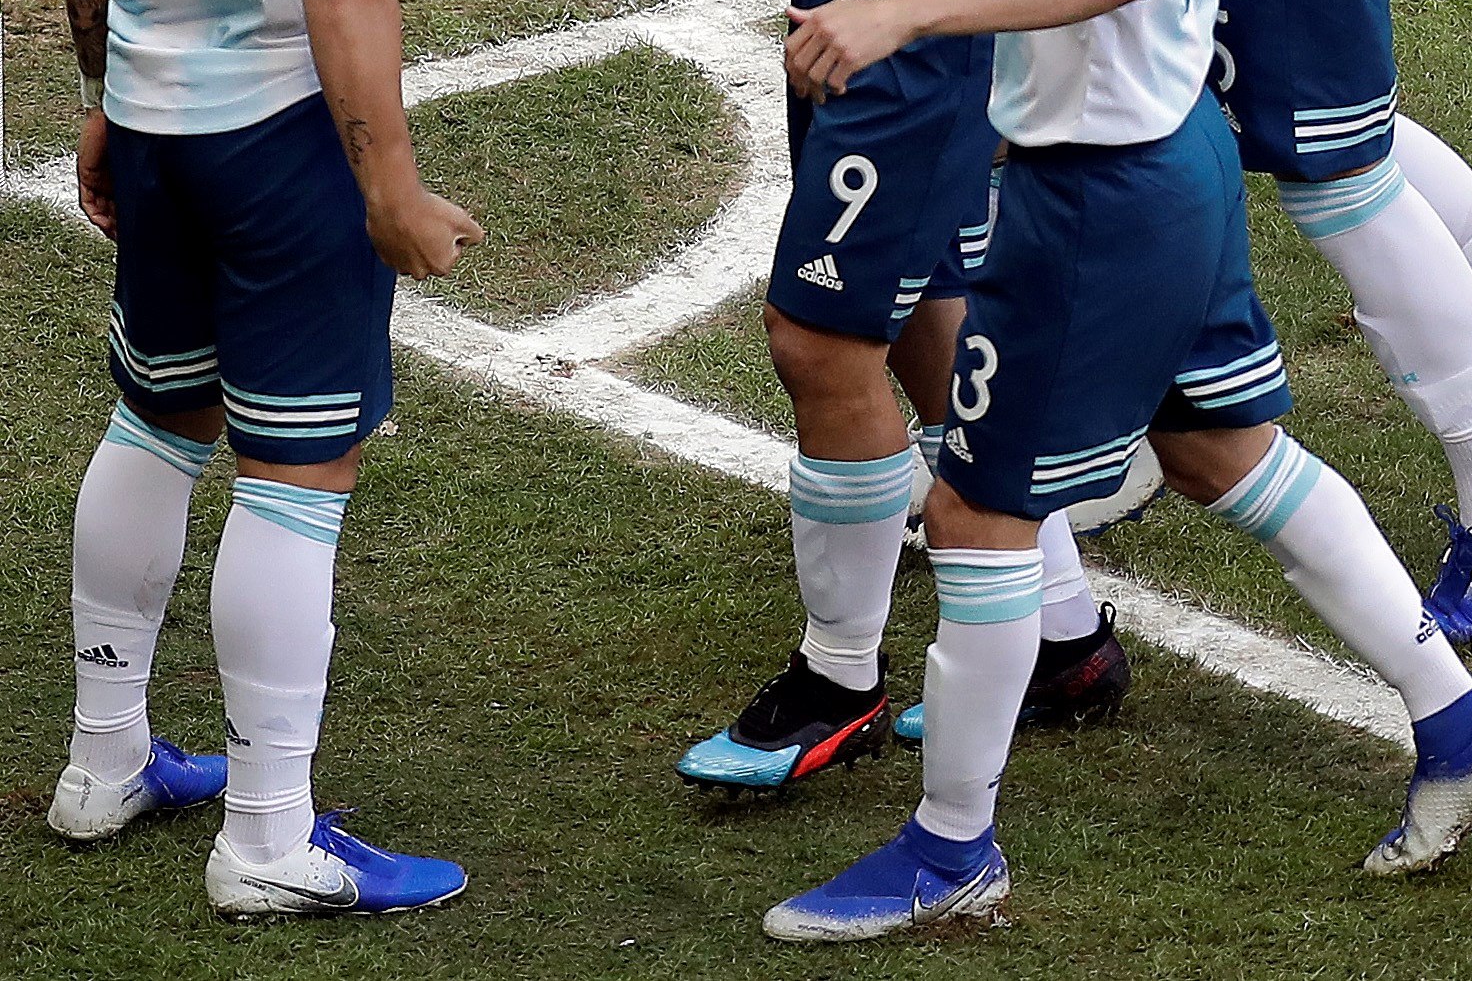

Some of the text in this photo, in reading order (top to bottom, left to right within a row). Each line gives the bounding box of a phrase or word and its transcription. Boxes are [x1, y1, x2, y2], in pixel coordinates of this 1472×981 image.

[825, 154, 878, 244] 9
[797, 267, 844, 291] adidas
[952, 334, 999, 422] 3
